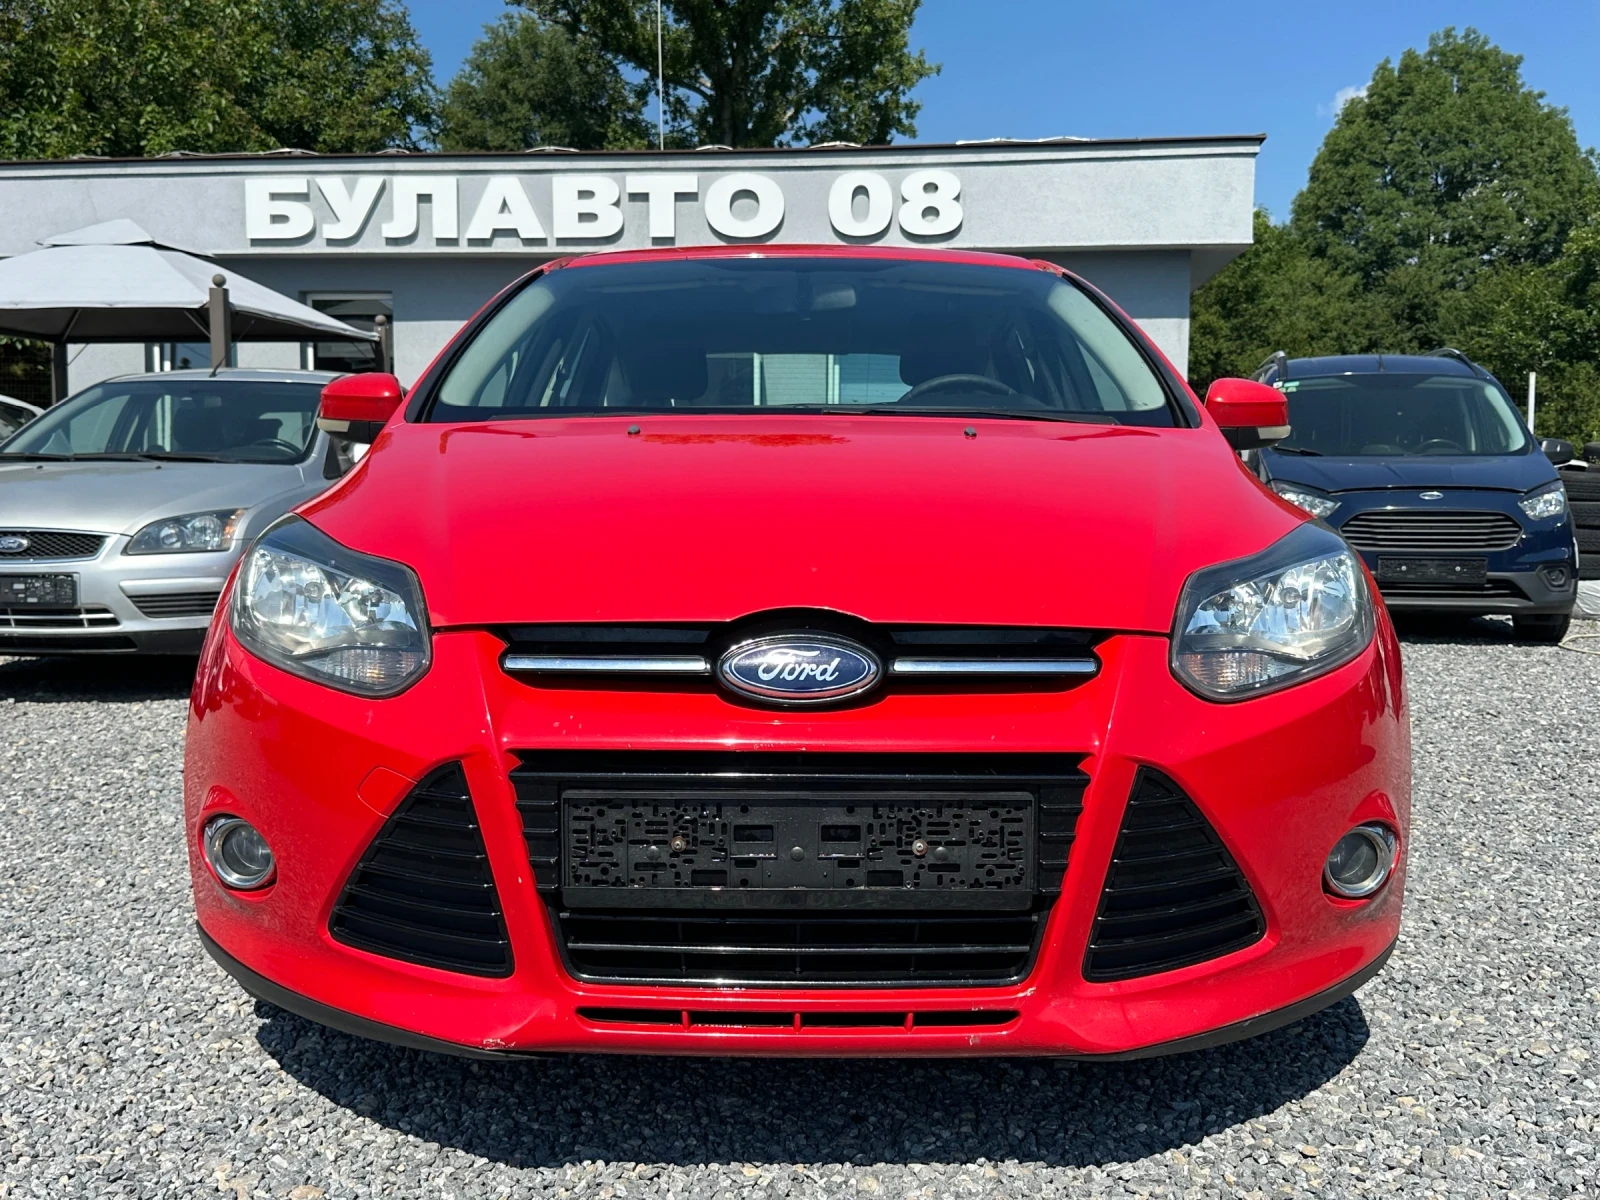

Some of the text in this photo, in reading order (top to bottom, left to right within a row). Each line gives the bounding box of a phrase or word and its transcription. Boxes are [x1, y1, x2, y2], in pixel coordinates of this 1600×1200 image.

[245, 170, 965, 242] БУЛАВТО 08
[757, 648, 842, 682] Ford
